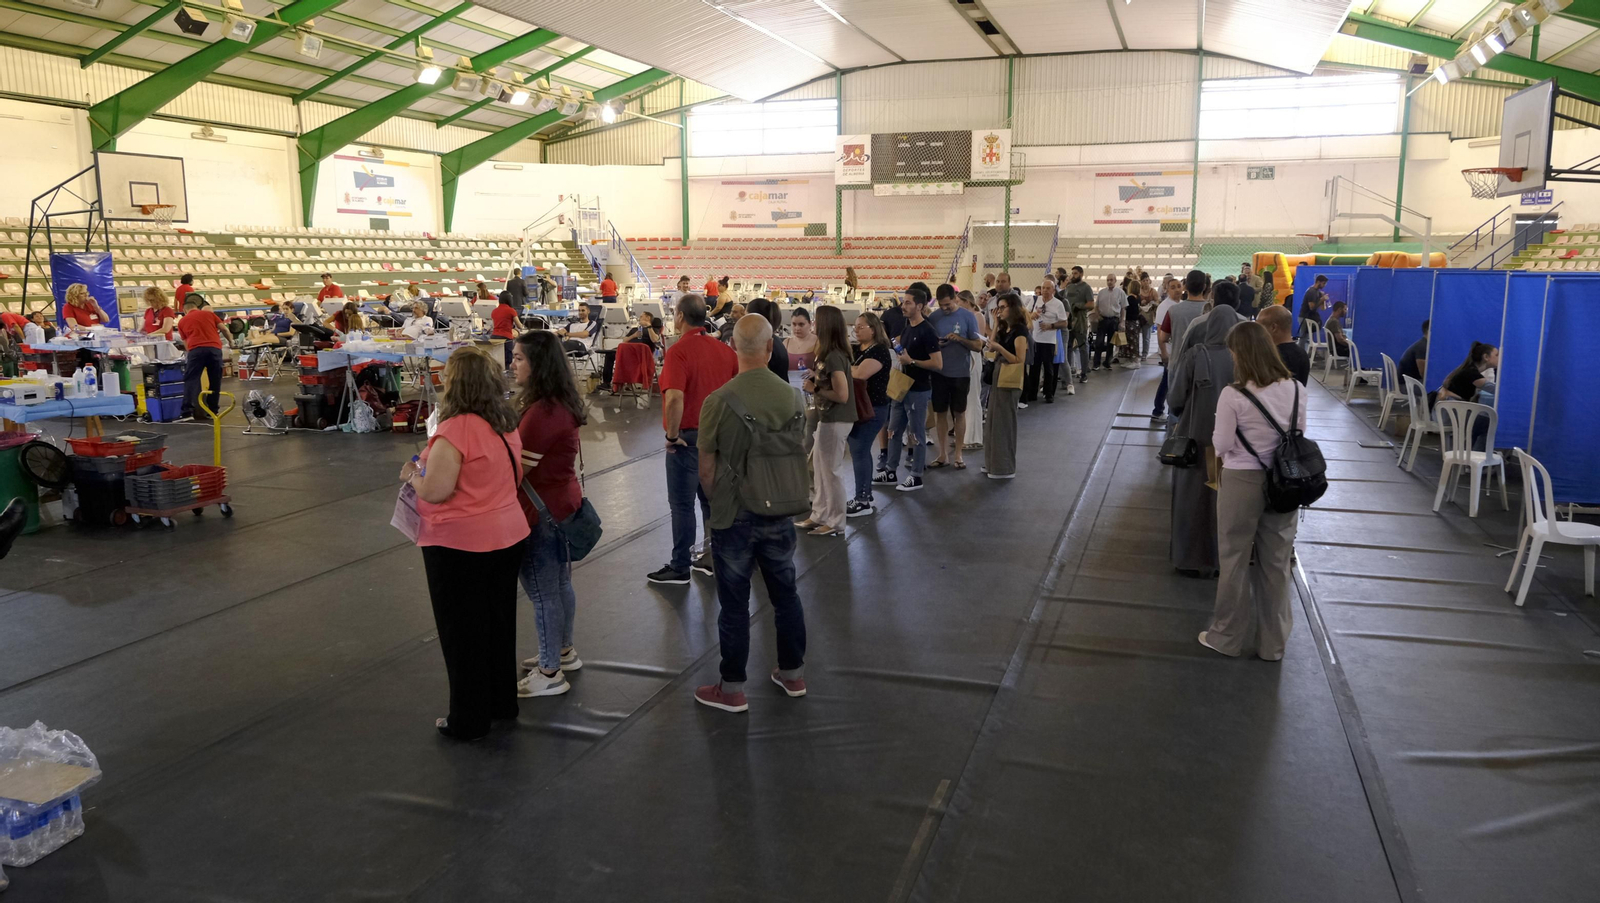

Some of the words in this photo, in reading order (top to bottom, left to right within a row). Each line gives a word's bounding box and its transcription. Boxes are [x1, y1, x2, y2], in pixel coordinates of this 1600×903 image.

[383, 196, 407, 206] cajamar
[748, 190, 788, 202] cajamar
[1156, 205, 1191, 215] cajamar
